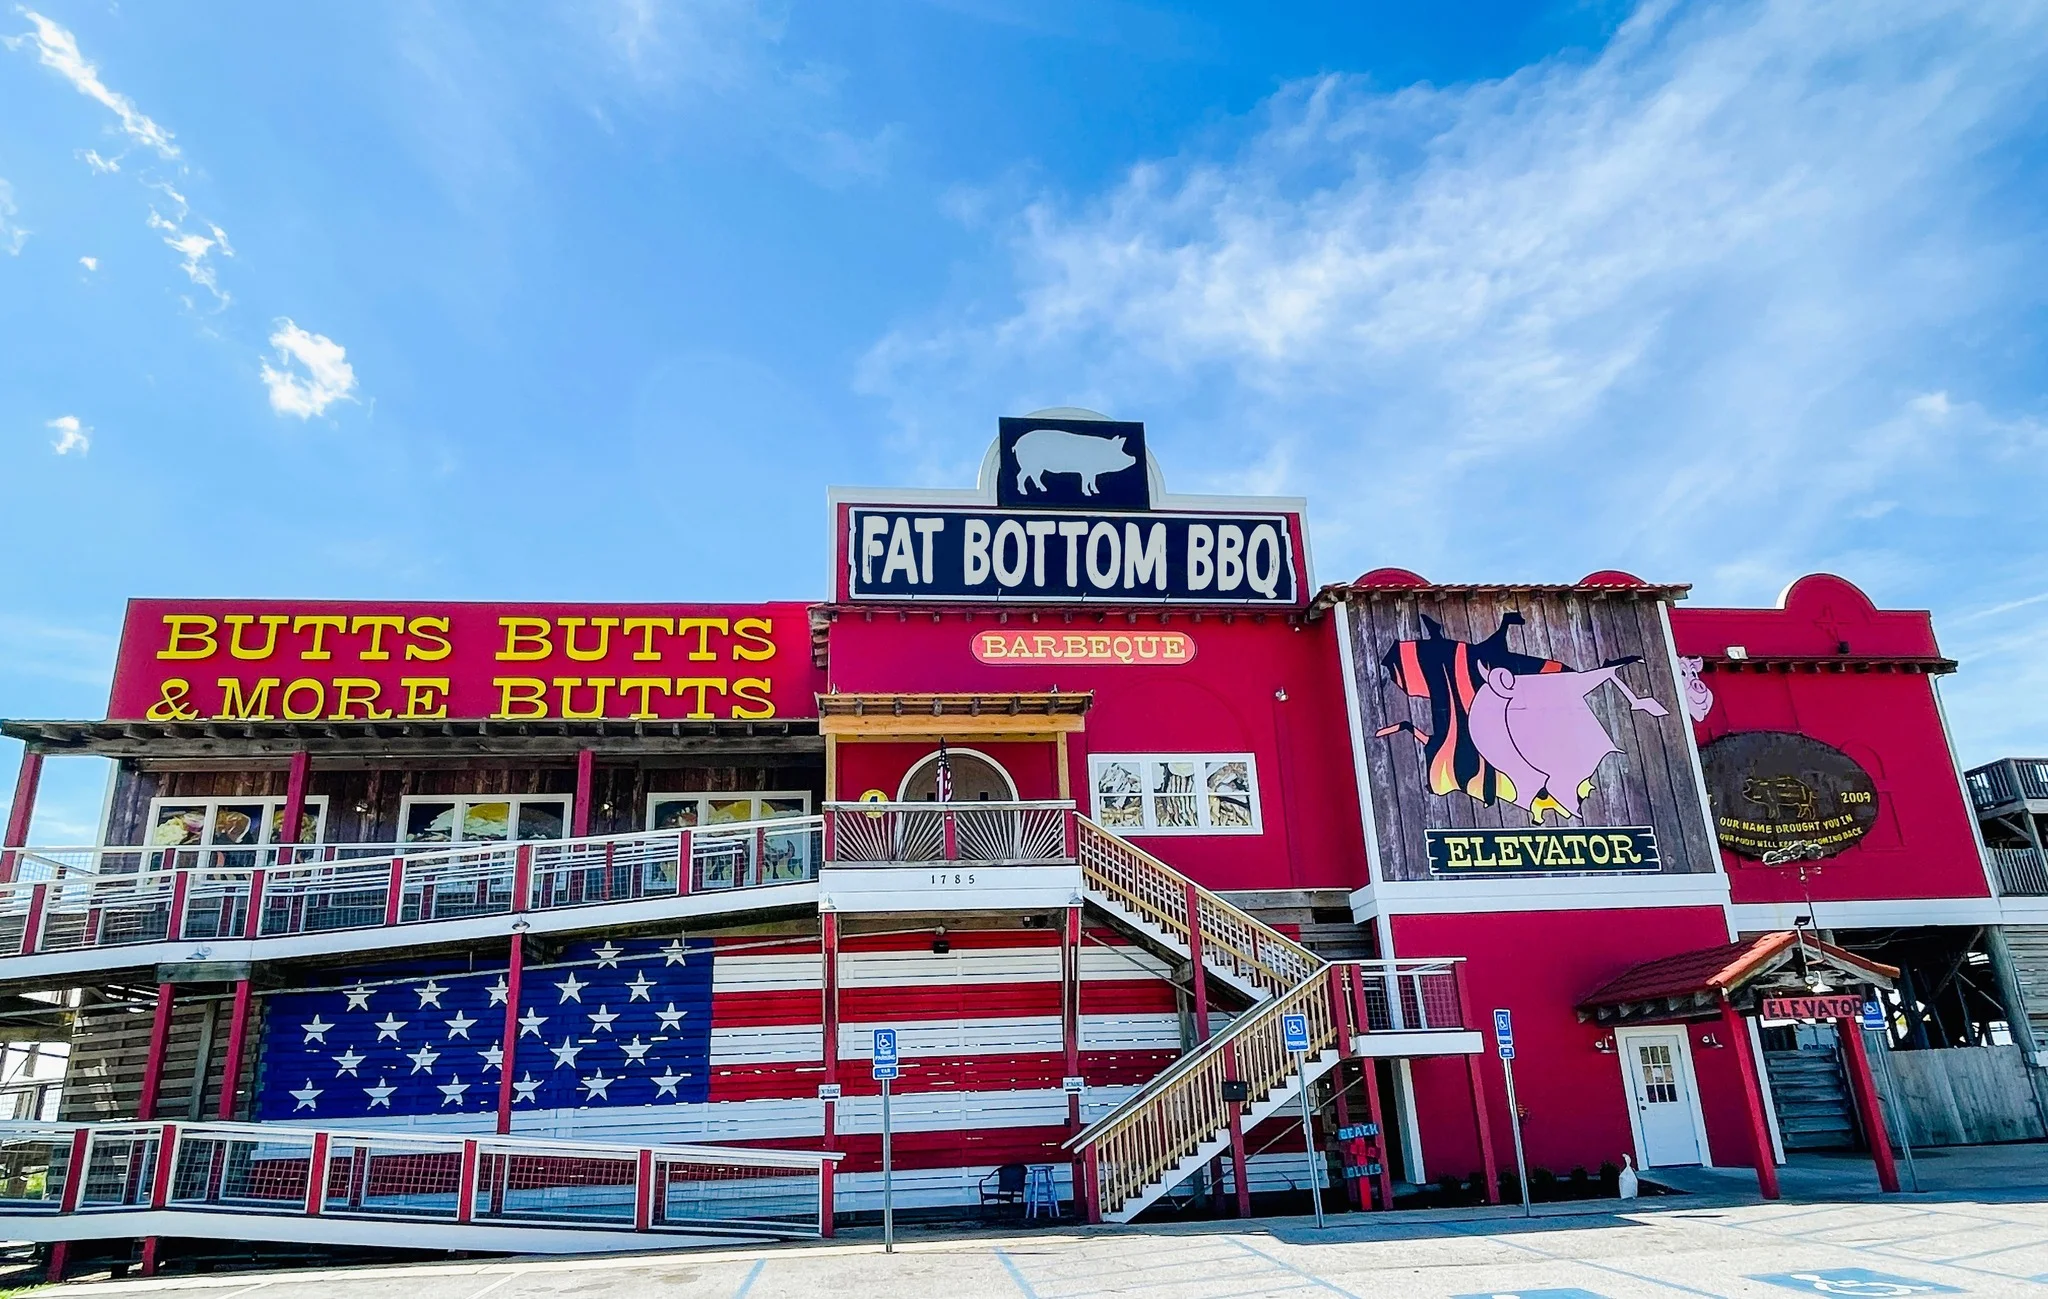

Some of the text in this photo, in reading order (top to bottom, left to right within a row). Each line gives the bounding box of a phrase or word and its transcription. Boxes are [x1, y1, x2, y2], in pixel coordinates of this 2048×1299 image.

[862, 515, 1281, 599] FAT BOTTOM BBQ
[156, 614, 777, 661] BUTTS BUTTS
[981, 635, 1186, 663] BARBEQUE
[145, 677, 777, 721] & MORE BUTTS
[1840, 792, 1872, 804] 2009
[1719, 813, 1854, 834] OUR NAME BROUGHT YOU IN
[1719, 832, 1735, 842] OUR
[1757, 840, 1778, 848] WILL
[1842, 827, 1864, 840] BACK
[1444, 834, 1642, 867] ELEVATOR
[931, 874, 975, 885] 1785
[1767, 997, 1864, 1018] ELEVATOR
[1338, 1123, 1379, 1140] BEACH
